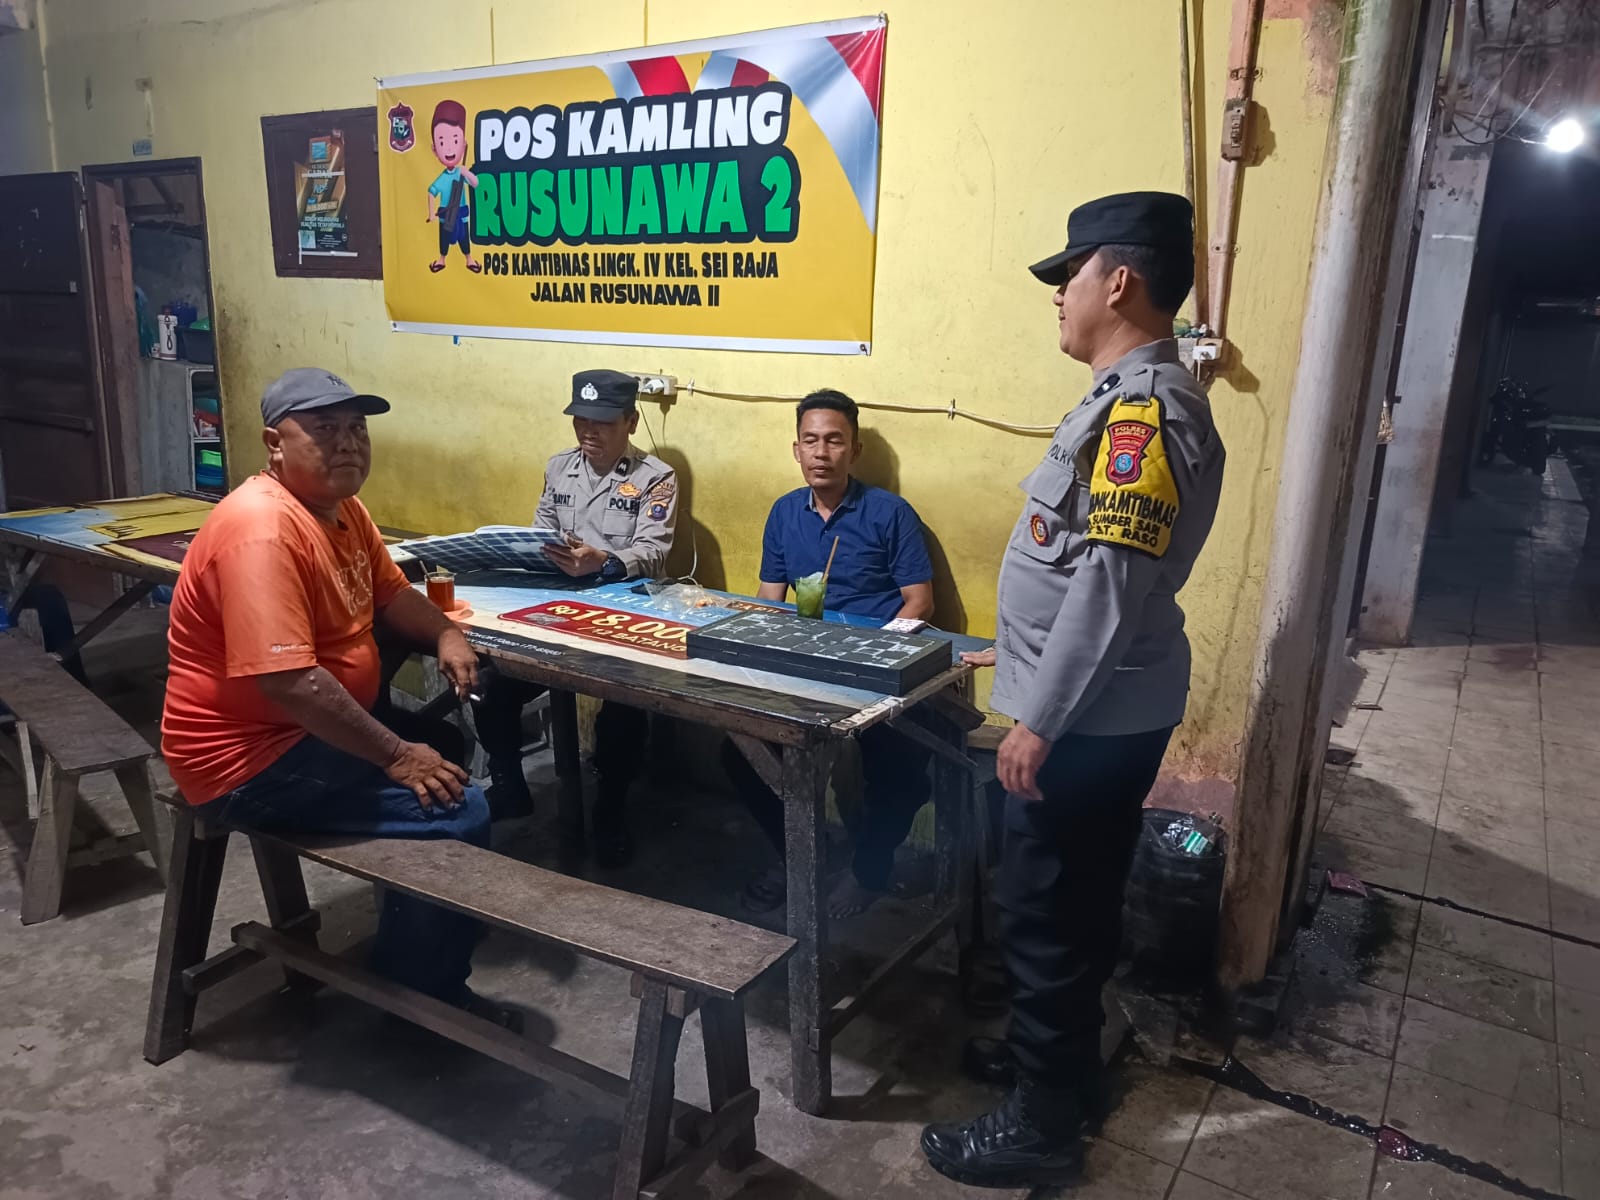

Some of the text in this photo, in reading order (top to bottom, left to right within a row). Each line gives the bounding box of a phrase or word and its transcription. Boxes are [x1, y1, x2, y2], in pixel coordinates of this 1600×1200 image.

[480, 91, 784, 162] POS KAMLING
[474, 155, 793, 238] RUSUNAWA 2
[483, 251, 779, 278] POS KAMTIBNAS LINGK. IV KEL. SEI RAJA
[530, 281, 720, 307] JALAN RUSUNAWA II
[1114, 425, 1147, 435] POLRES
[1093, 514, 1161, 537] SUMBER SARI
[1121, 528, 1159, 548] RASO
